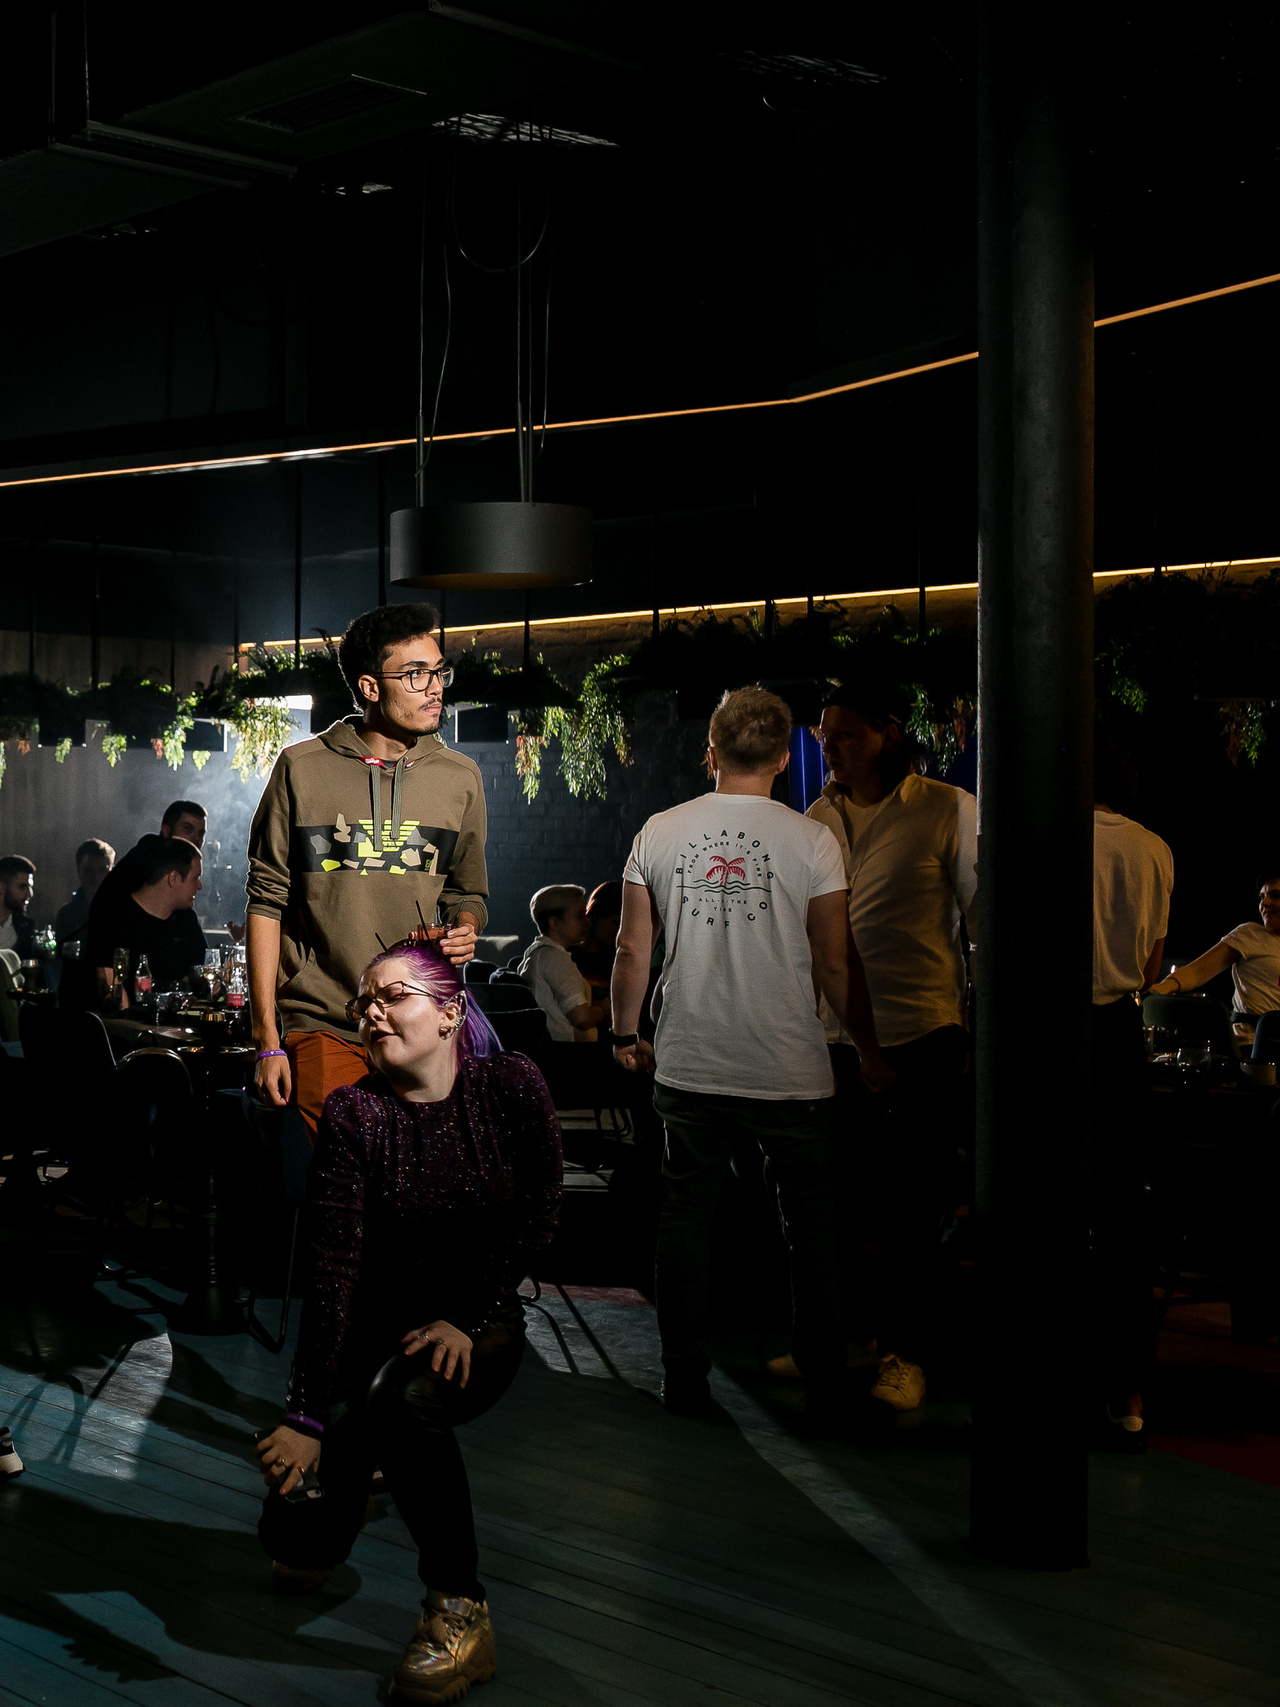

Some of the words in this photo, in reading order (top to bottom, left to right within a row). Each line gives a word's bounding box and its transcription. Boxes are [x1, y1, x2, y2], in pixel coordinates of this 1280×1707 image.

[676, 830, 774, 879] BILLABONG
[687, 853, 700, 874] FROM
[702, 841, 730, 852] WHERE
[682, 895, 730, 929] SURF
[747, 901, 768, 921] CO
